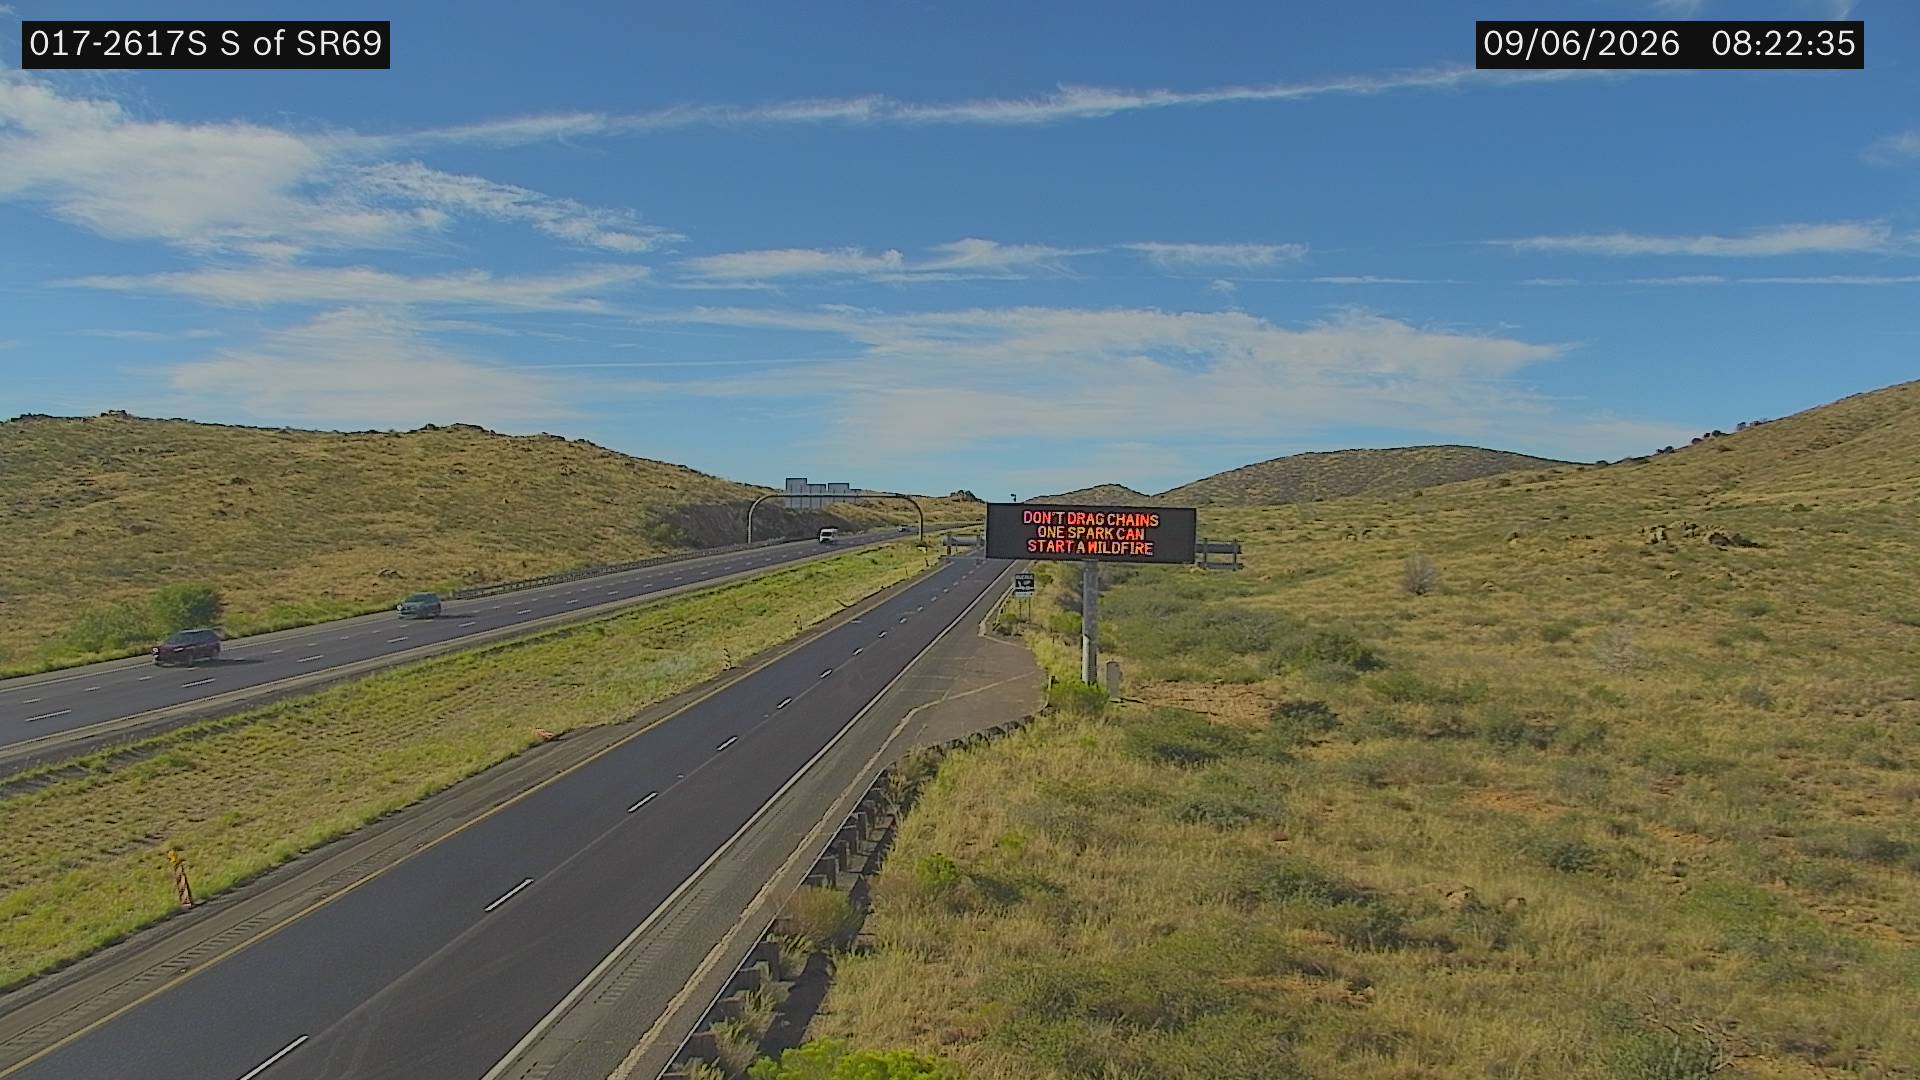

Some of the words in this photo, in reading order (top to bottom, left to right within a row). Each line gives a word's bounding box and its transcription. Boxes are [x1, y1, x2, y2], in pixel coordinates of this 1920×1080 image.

[1023, 511, 1065, 525] DON'T
[1067, 512, 1105, 526] DRAG
[1107, 513, 1159, 527] CHAINS
[1038, 527, 1064, 539] ONE
[1067, 527, 1115, 540] SPARK
[1116, 528, 1145, 541] CAN
[1027, 539, 1074, 553] START
[1076, 540, 1086, 553] A
[1087, 541, 1154, 556] WILDFIRE
